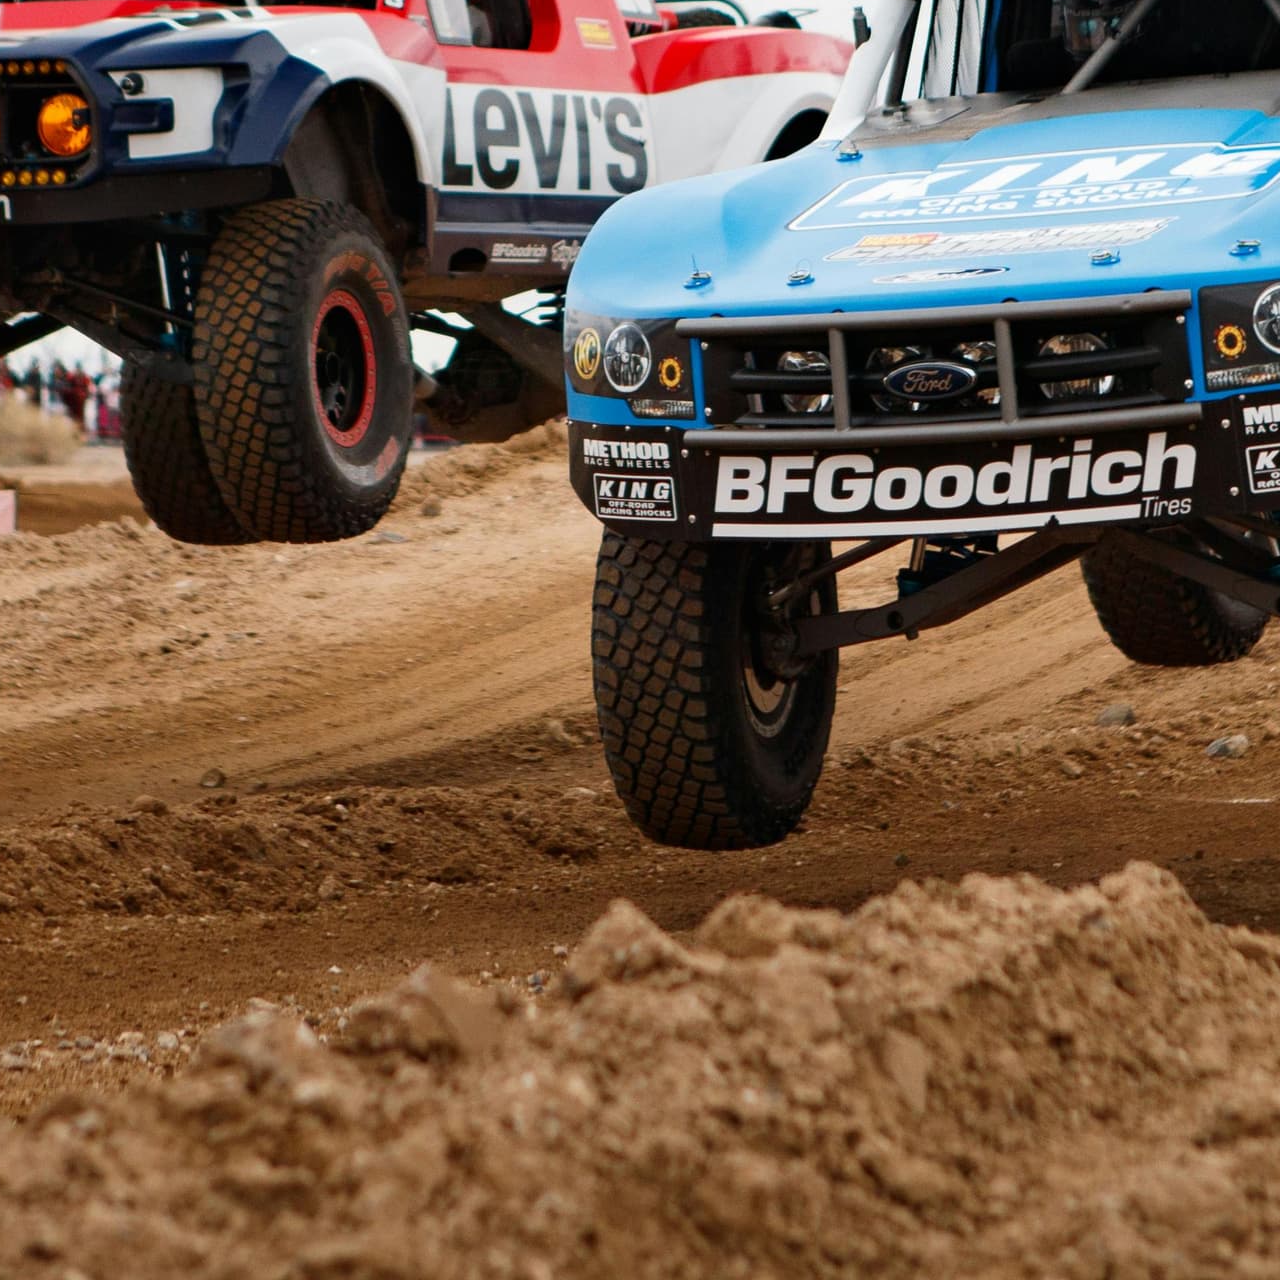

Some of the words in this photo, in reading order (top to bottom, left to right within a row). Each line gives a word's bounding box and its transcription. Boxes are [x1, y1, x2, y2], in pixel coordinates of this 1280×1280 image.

[857, 200, 1019, 219] RACING
[1032, 186, 1203, 208] SHOCKS
[903, 369, 953, 394] Ford
[583, 438, 670, 460] METHOD
[584, 456, 611, 467] RACE
[615, 460, 671, 469] WHEELS
[713, 432, 1198, 515] BFGoodrich
[599, 480, 670, 499] KING
[600, 506, 633, 516] RACING
[635, 509, 673, 518] SHOCKS
[608, 500, 656, 509] OFF-ROAD
[1140, 496, 1193, 519] Tires
